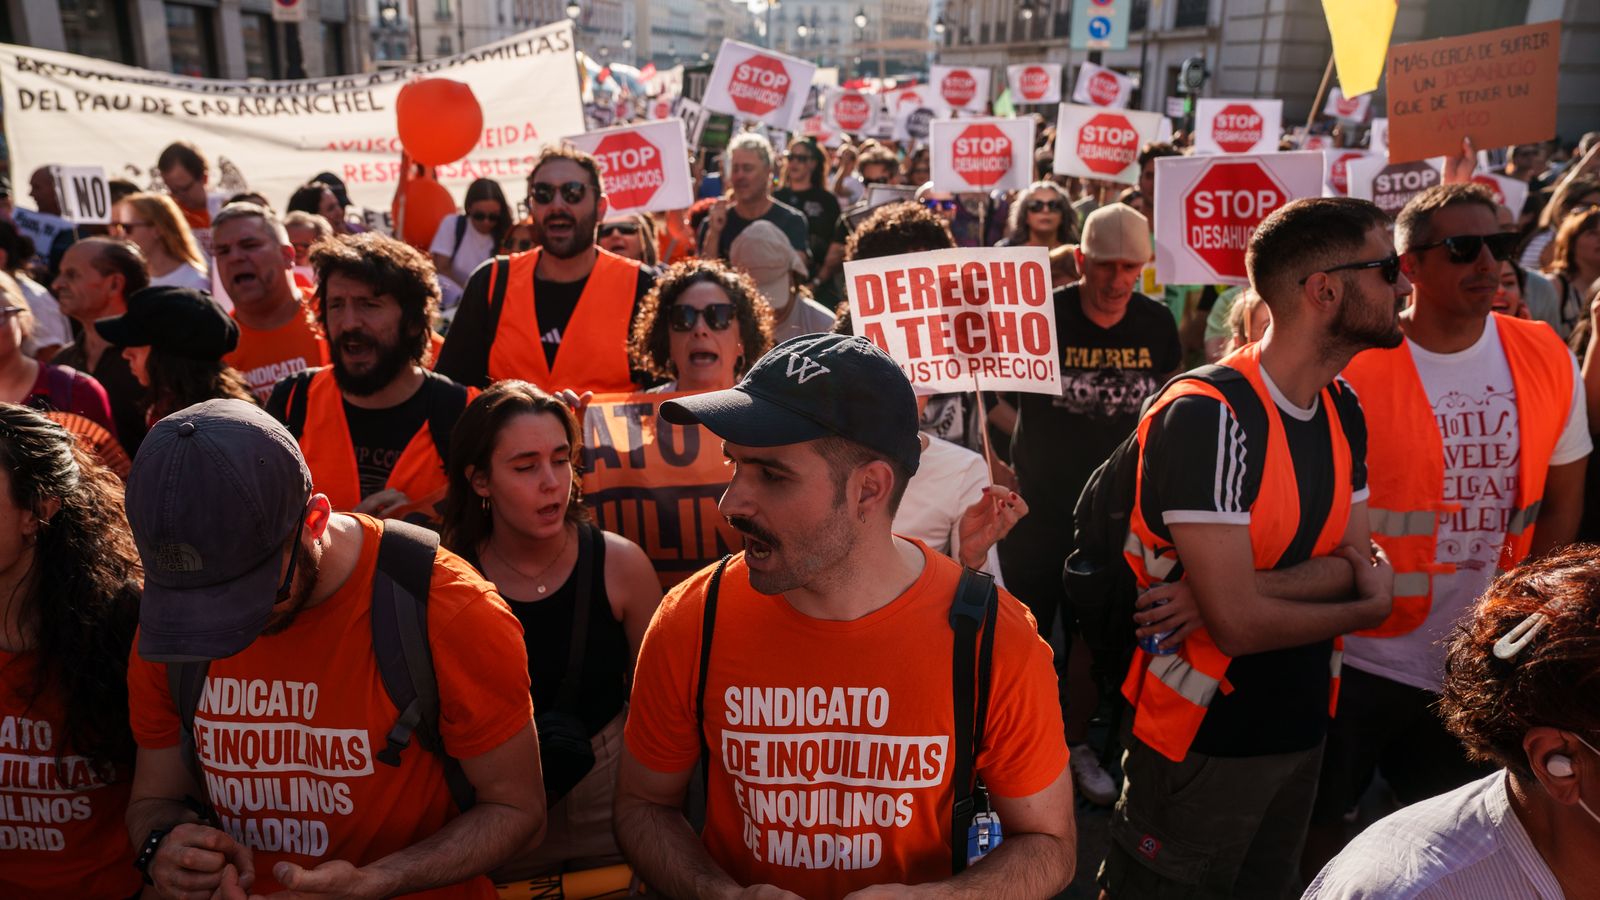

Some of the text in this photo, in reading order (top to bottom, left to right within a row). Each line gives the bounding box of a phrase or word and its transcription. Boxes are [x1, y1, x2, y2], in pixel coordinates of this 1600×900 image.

[1431, 45, 1476, 67] CERCA
[1478, 43, 1494, 60] DE
[1501, 32, 1549, 53] SUFRIR
[736, 63, 788, 89] STOP
[1414, 75, 1435, 93] UN
[18, 88, 385, 117] DEL PAU DE CARABANCHEL
[1394, 83, 1529, 115] QUE DE TENER UN
[1083, 124, 1135, 145] STOP
[1216, 114, 1260, 128] STOP
[594, 146, 655, 175] STOP
[955, 137, 1008, 155] STOP
[1376, 169, 1437, 192] STOP
[73, 176, 106, 219] NO
[1193, 190, 1278, 219] STOP
[854, 261, 1047, 317] DERECHO
[864, 311, 1051, 360] A TECHO
[968, 357, 1055, 382] PRECIO!
[1065, 346, 1153, 369] MAREA
[724, 686, 889, 728] SINDICATO
[0, 716, 52, 752] ATO
[213, 727, 367, 770] INQUILINAS
[726, 737, 942, 782] DE INQUILINAS
[735, 779, 914, 829] E INQUILINOS
[221, 816, 329, 857] MADRID
[744, 812, 883, 871] DE MADRID
